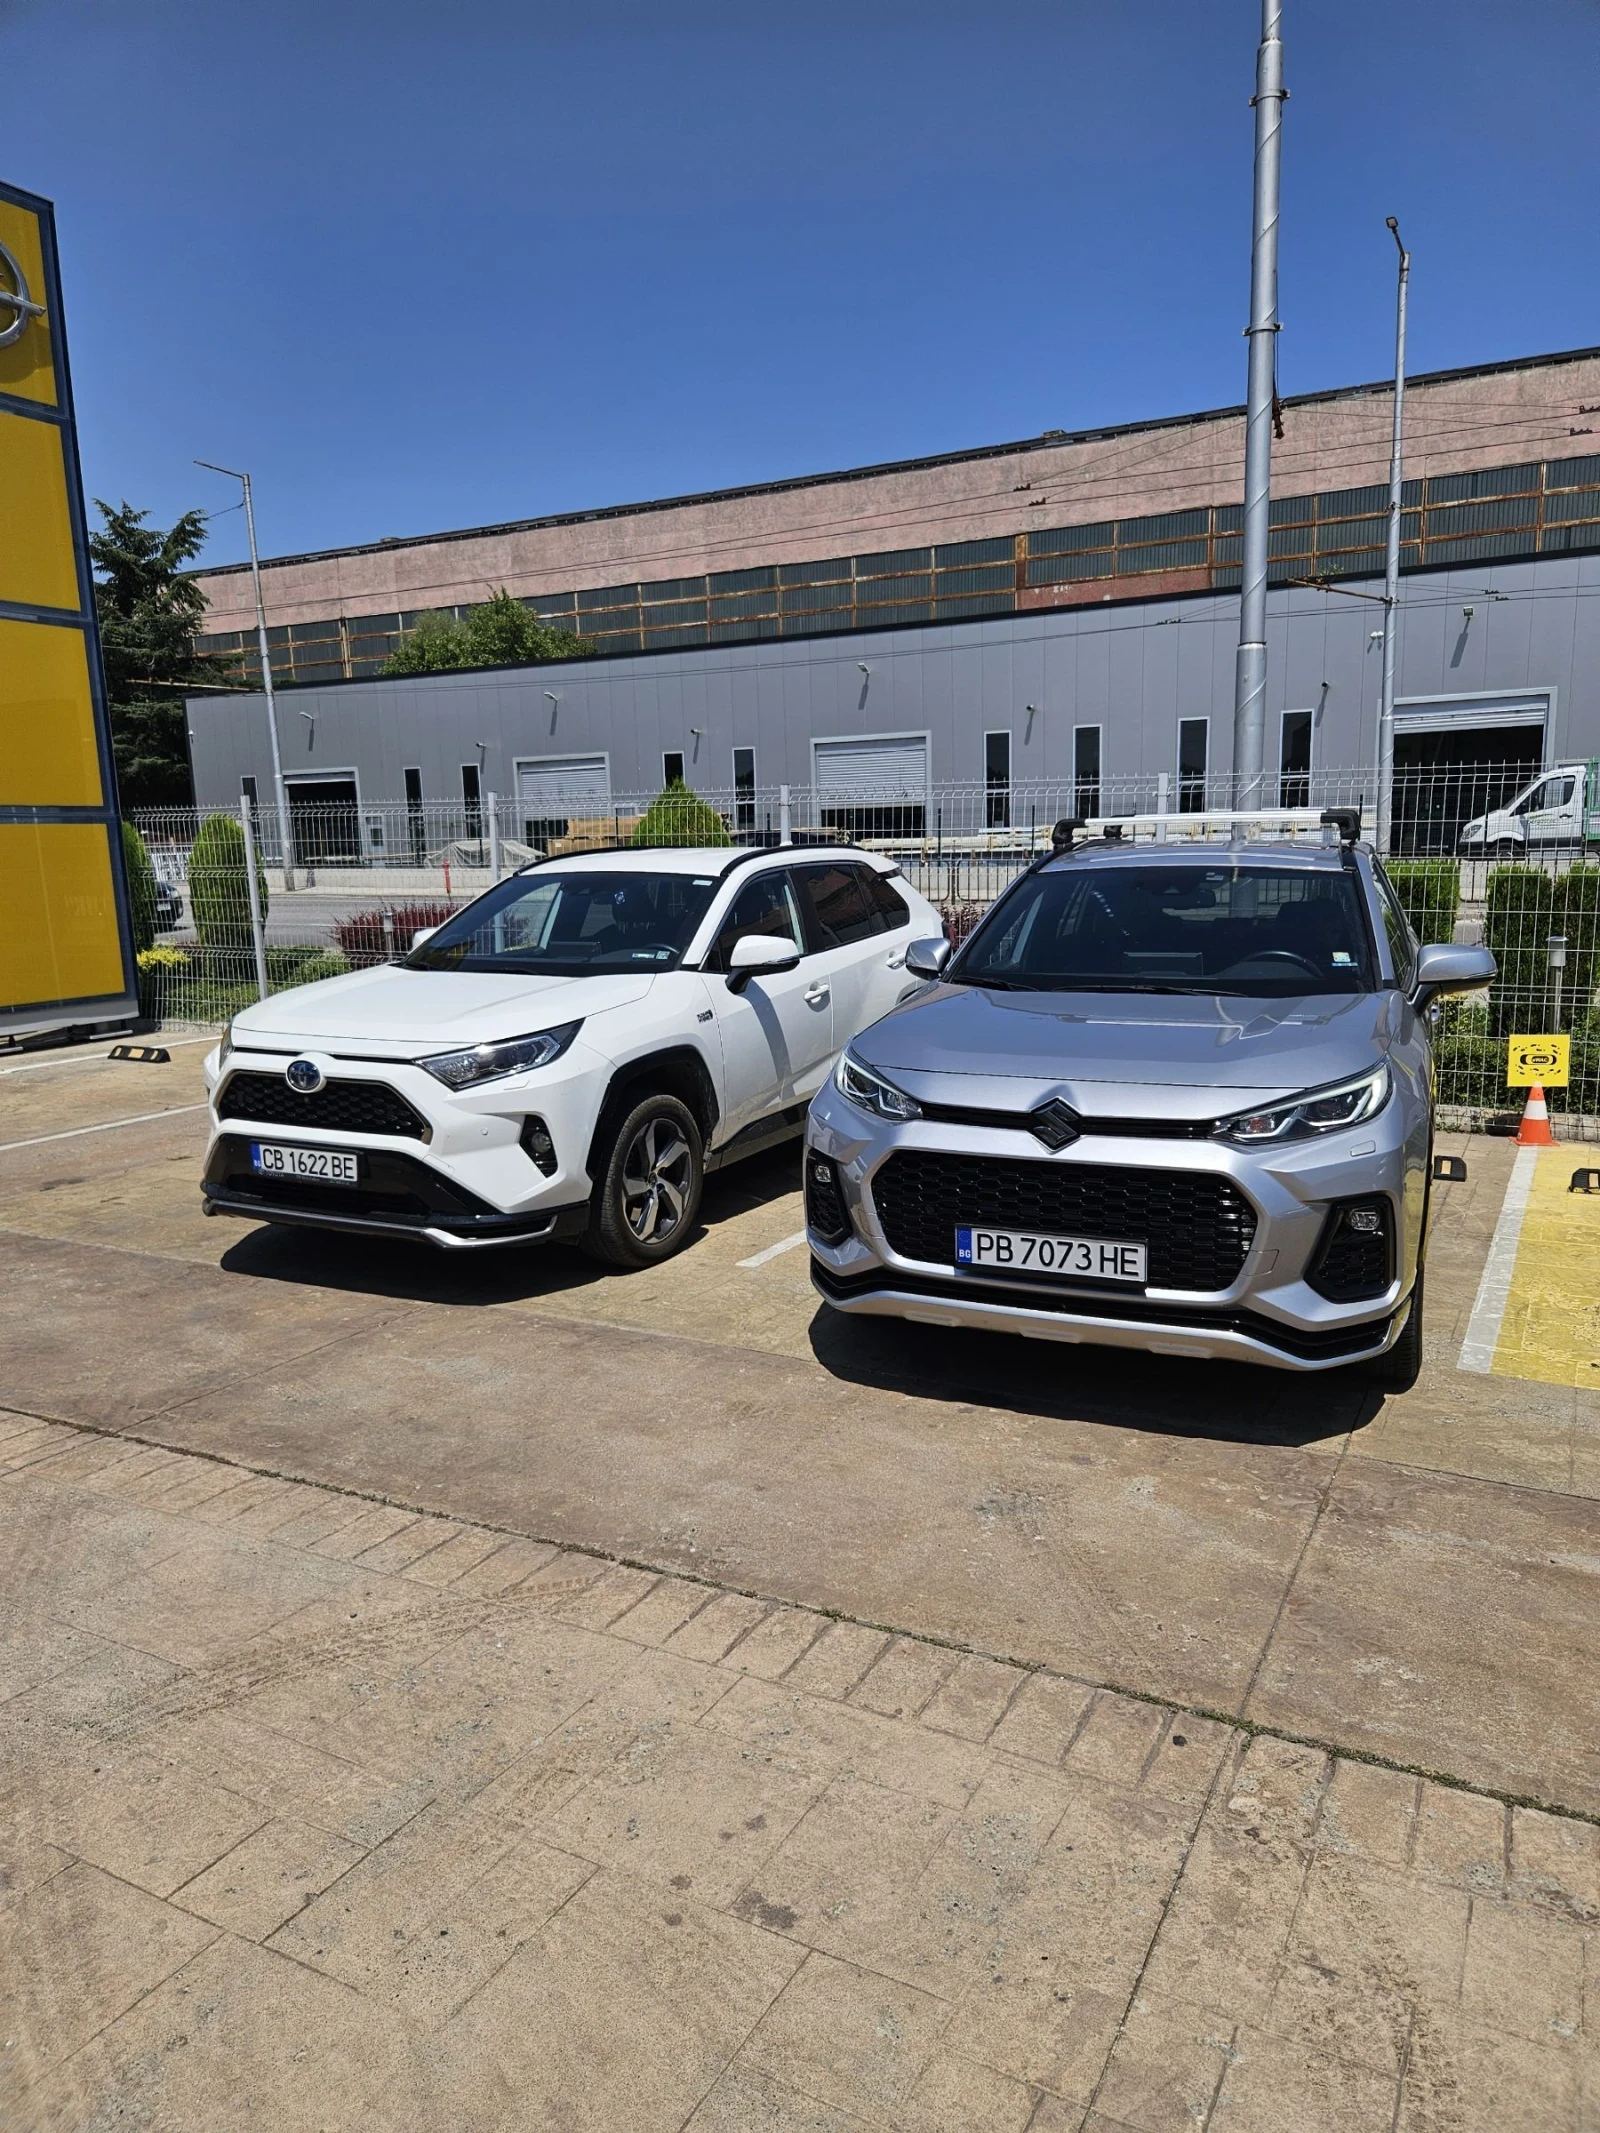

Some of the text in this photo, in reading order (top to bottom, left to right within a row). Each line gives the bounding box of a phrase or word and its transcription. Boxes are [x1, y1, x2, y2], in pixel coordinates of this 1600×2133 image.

[262, 1148, 355, 1179] CB 1622 BE
[959, 1249, 971, 1258] BG
[976, 1233, 1139, 1276] PB 7073 HE
